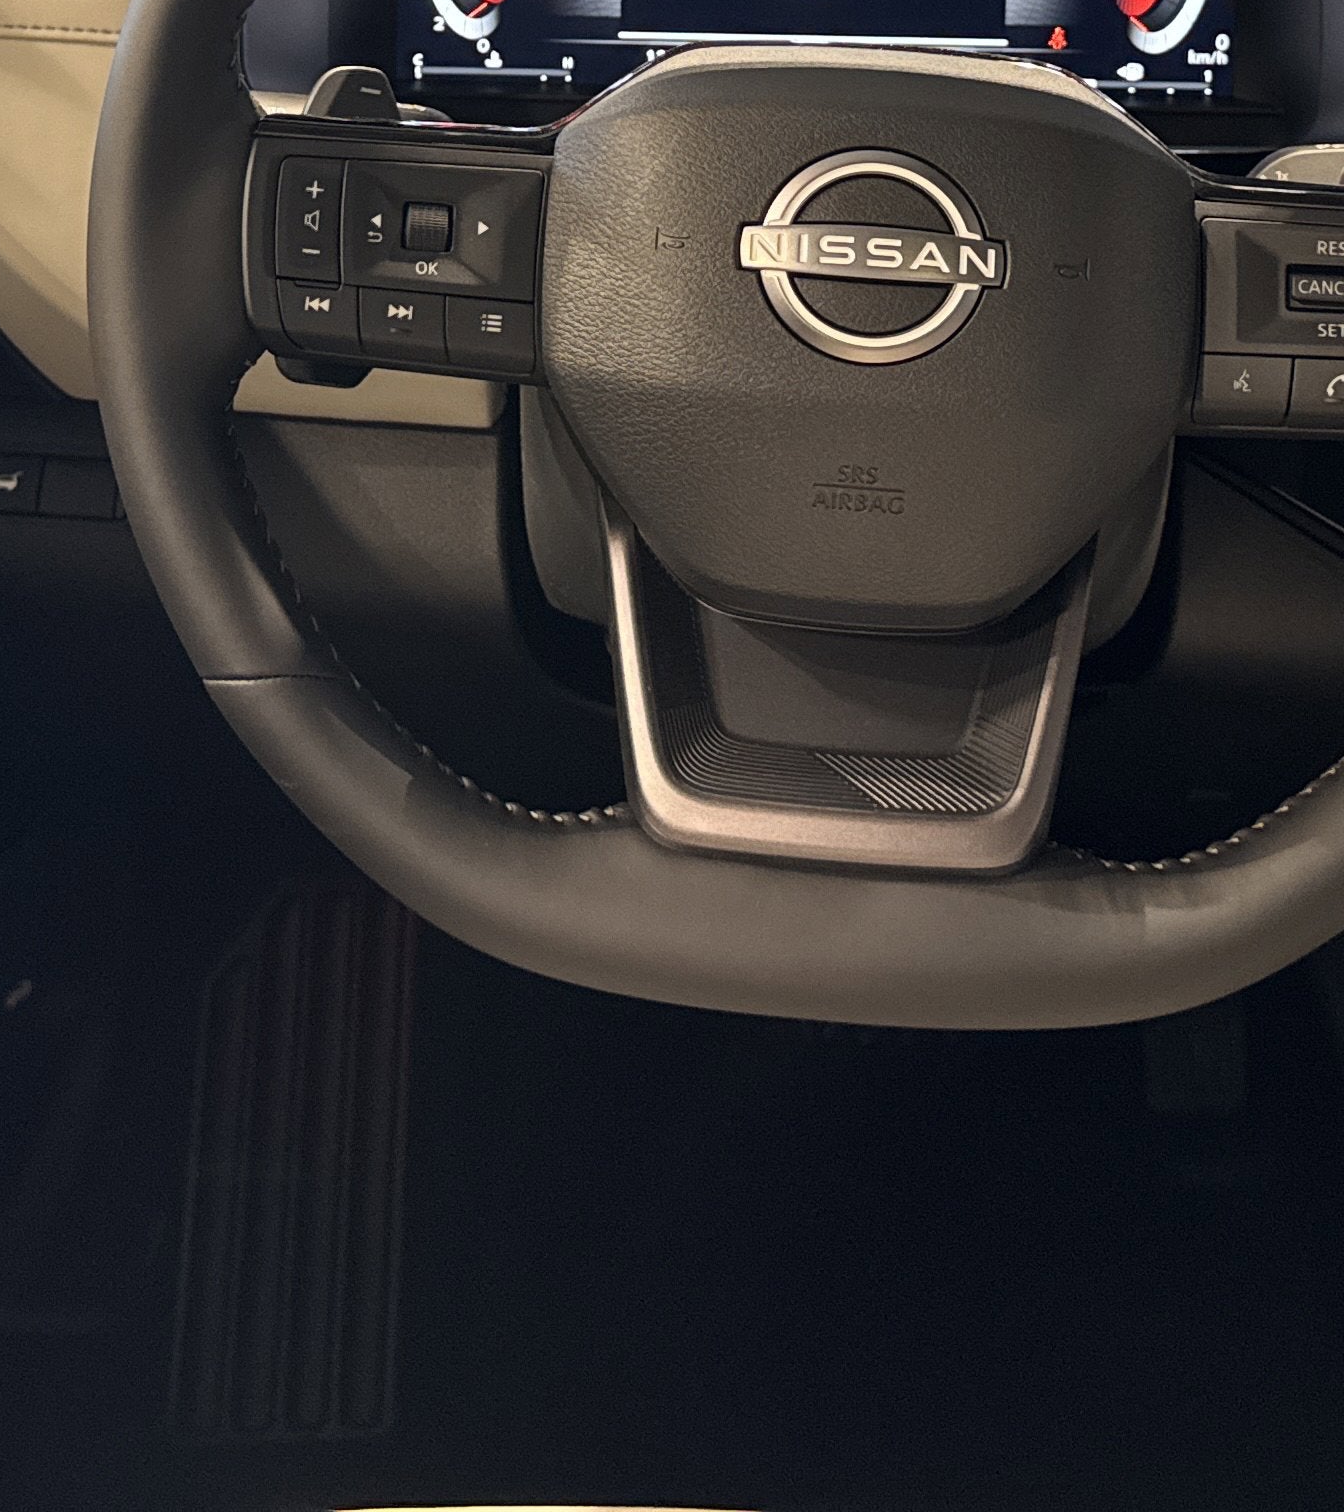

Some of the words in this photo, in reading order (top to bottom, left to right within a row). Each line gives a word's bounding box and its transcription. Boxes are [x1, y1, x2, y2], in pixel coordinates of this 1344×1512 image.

[432, 15, 446, 31] 2
[1187, 48, 1230, 66] km/h
[750, 233, 997, 279] NISSAN
[415, 261, 439, 276] OK
[838, 464, 879, 485] SRS
[812, 491, 905, 515] AIRBAG
